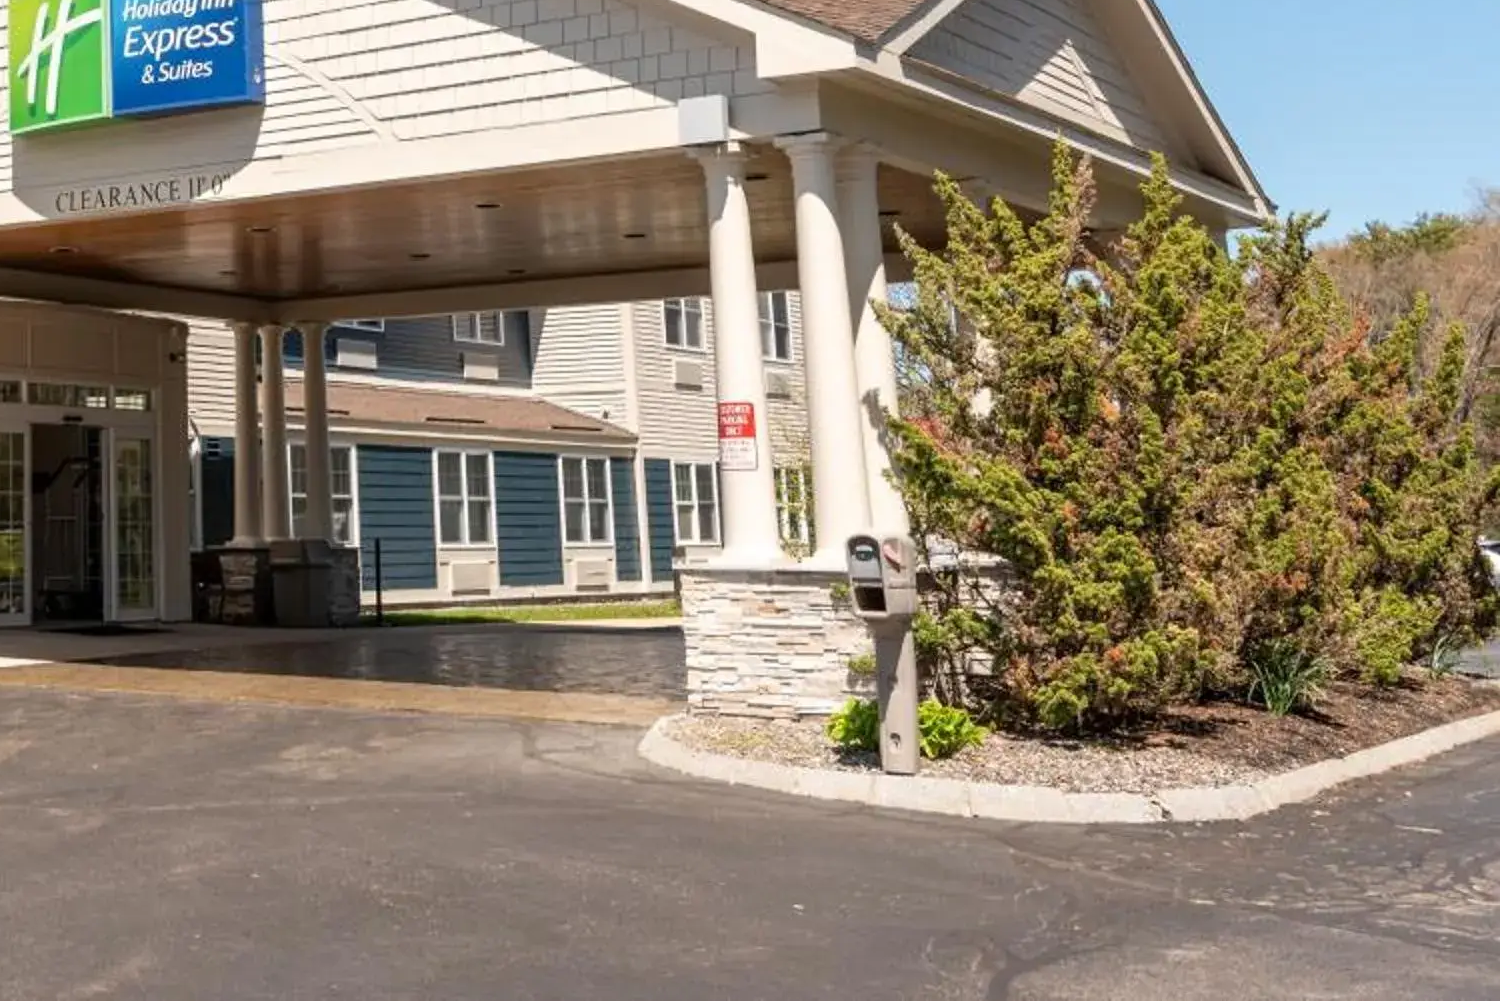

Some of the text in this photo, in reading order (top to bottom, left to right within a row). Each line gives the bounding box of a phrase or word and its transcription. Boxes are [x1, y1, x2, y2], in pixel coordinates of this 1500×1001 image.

[123, 20, 236, 61] Express
[141, 59, 213, 84] & Suites
[55, 179, 181, 213] CLEARANCE
